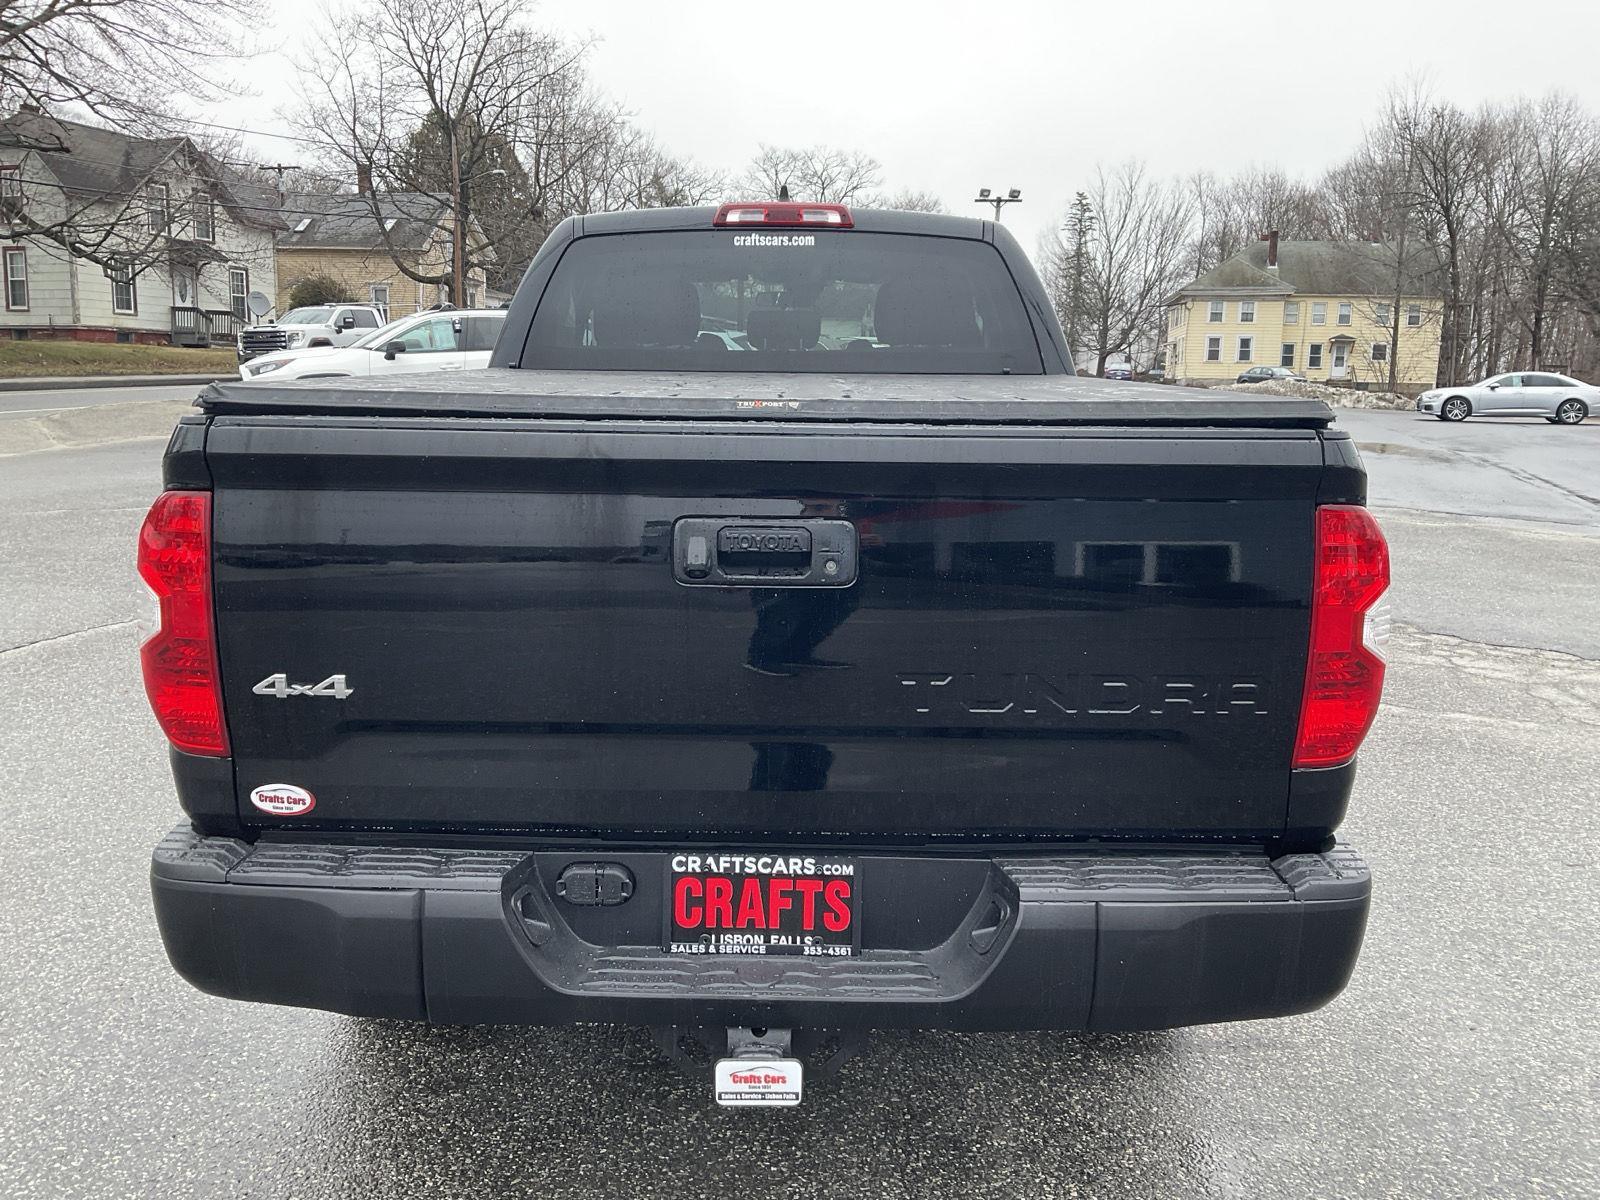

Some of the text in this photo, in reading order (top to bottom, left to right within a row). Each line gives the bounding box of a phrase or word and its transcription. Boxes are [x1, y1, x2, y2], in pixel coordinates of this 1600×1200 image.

[733, 233, 815, 247] craftscars.com
[726, 534, 804, 550] TOYOTA
[252, 673, 354, 698] 4x4
[897, 673, 1269, 714] TUNDRA
[259, 793, 307, 806] Crafts Cars
[671, 855, 854, 876] CRAFTSCARSCOM
[674, 876, 851, 932] CRAFTS
[670, 944, 852, 956] SALES & SERVICE 353-4361
[732, 1074, 787, 1084] Crafts Cars
